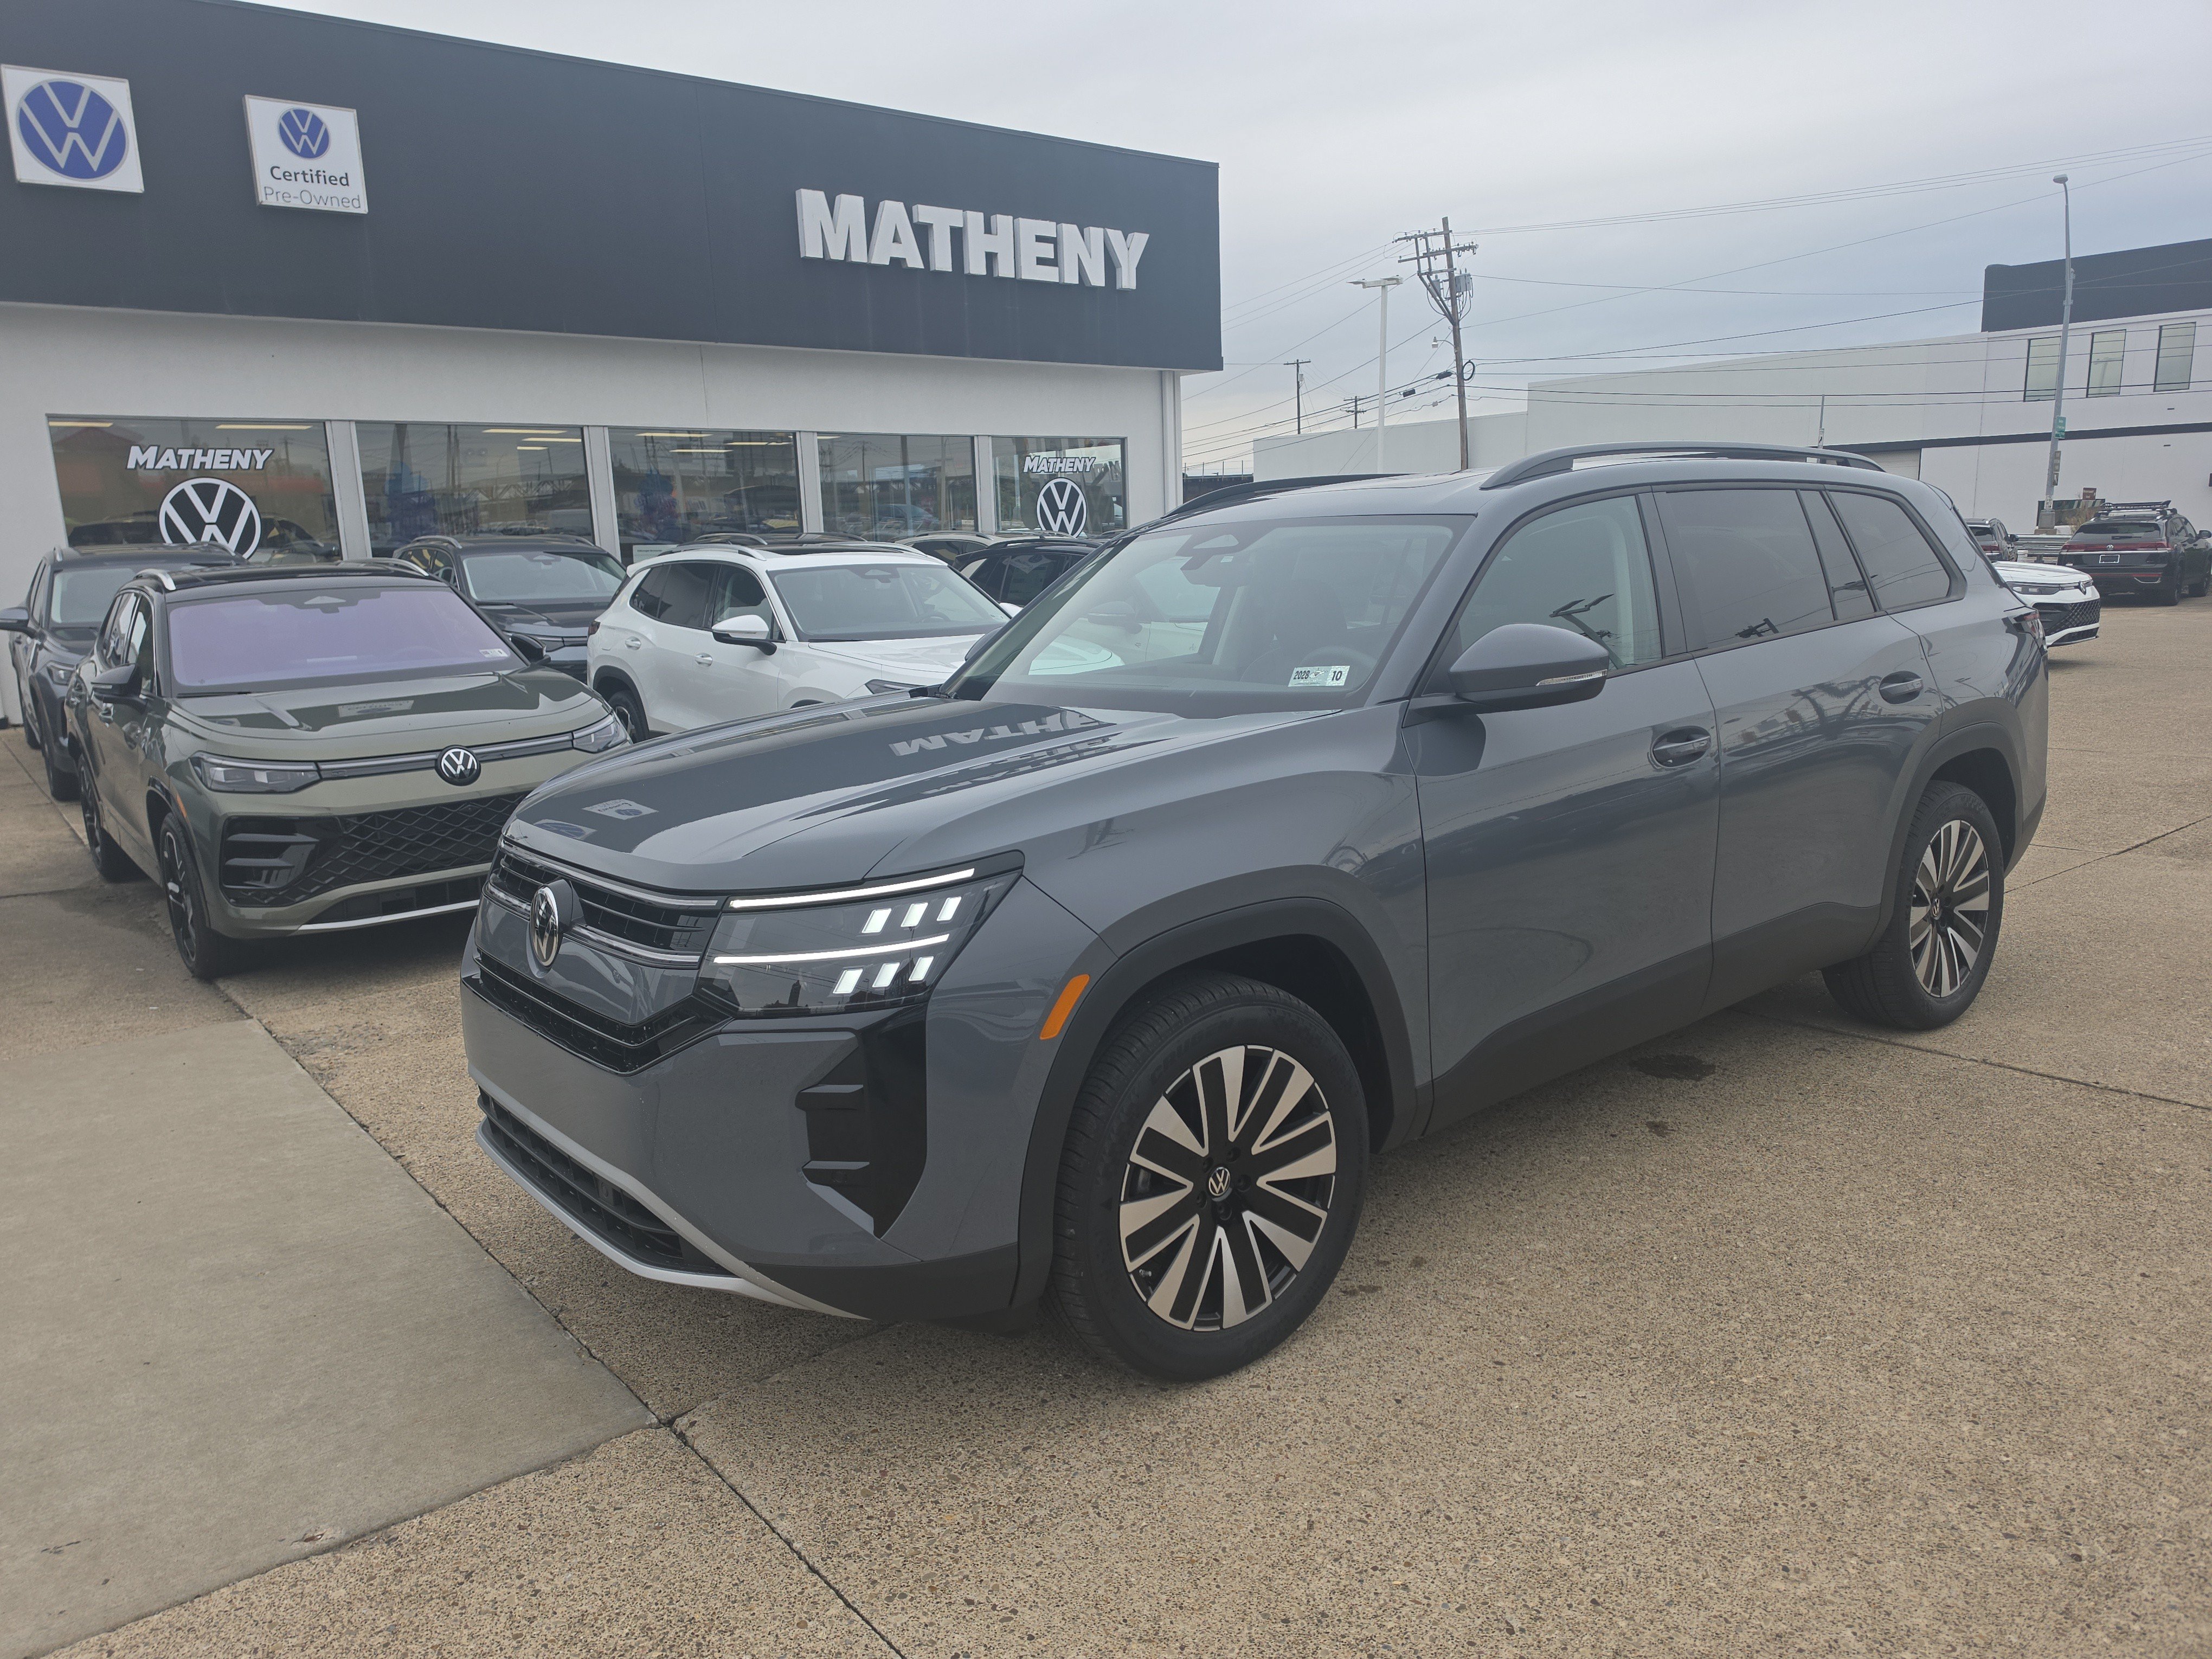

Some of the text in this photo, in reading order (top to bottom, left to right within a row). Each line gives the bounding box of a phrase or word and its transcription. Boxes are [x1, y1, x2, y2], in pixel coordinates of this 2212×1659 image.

[18, 79, 125, 173] VW
[279, 108, 328, 156] VW
[270, 166, 349, 187] Certified
[264, 186, 361, 209] Pre-Owned
[795, 189, 1149, 291] MATHENY
[127, 445, 273, 470] MATHENY
[1023, 455, 1096, 473] MATHENY
[1294, 670, 1342, 681] 2028 10
[442, 749, 477, 778] VW
[1209, 1167, 1230, 1196] VW
